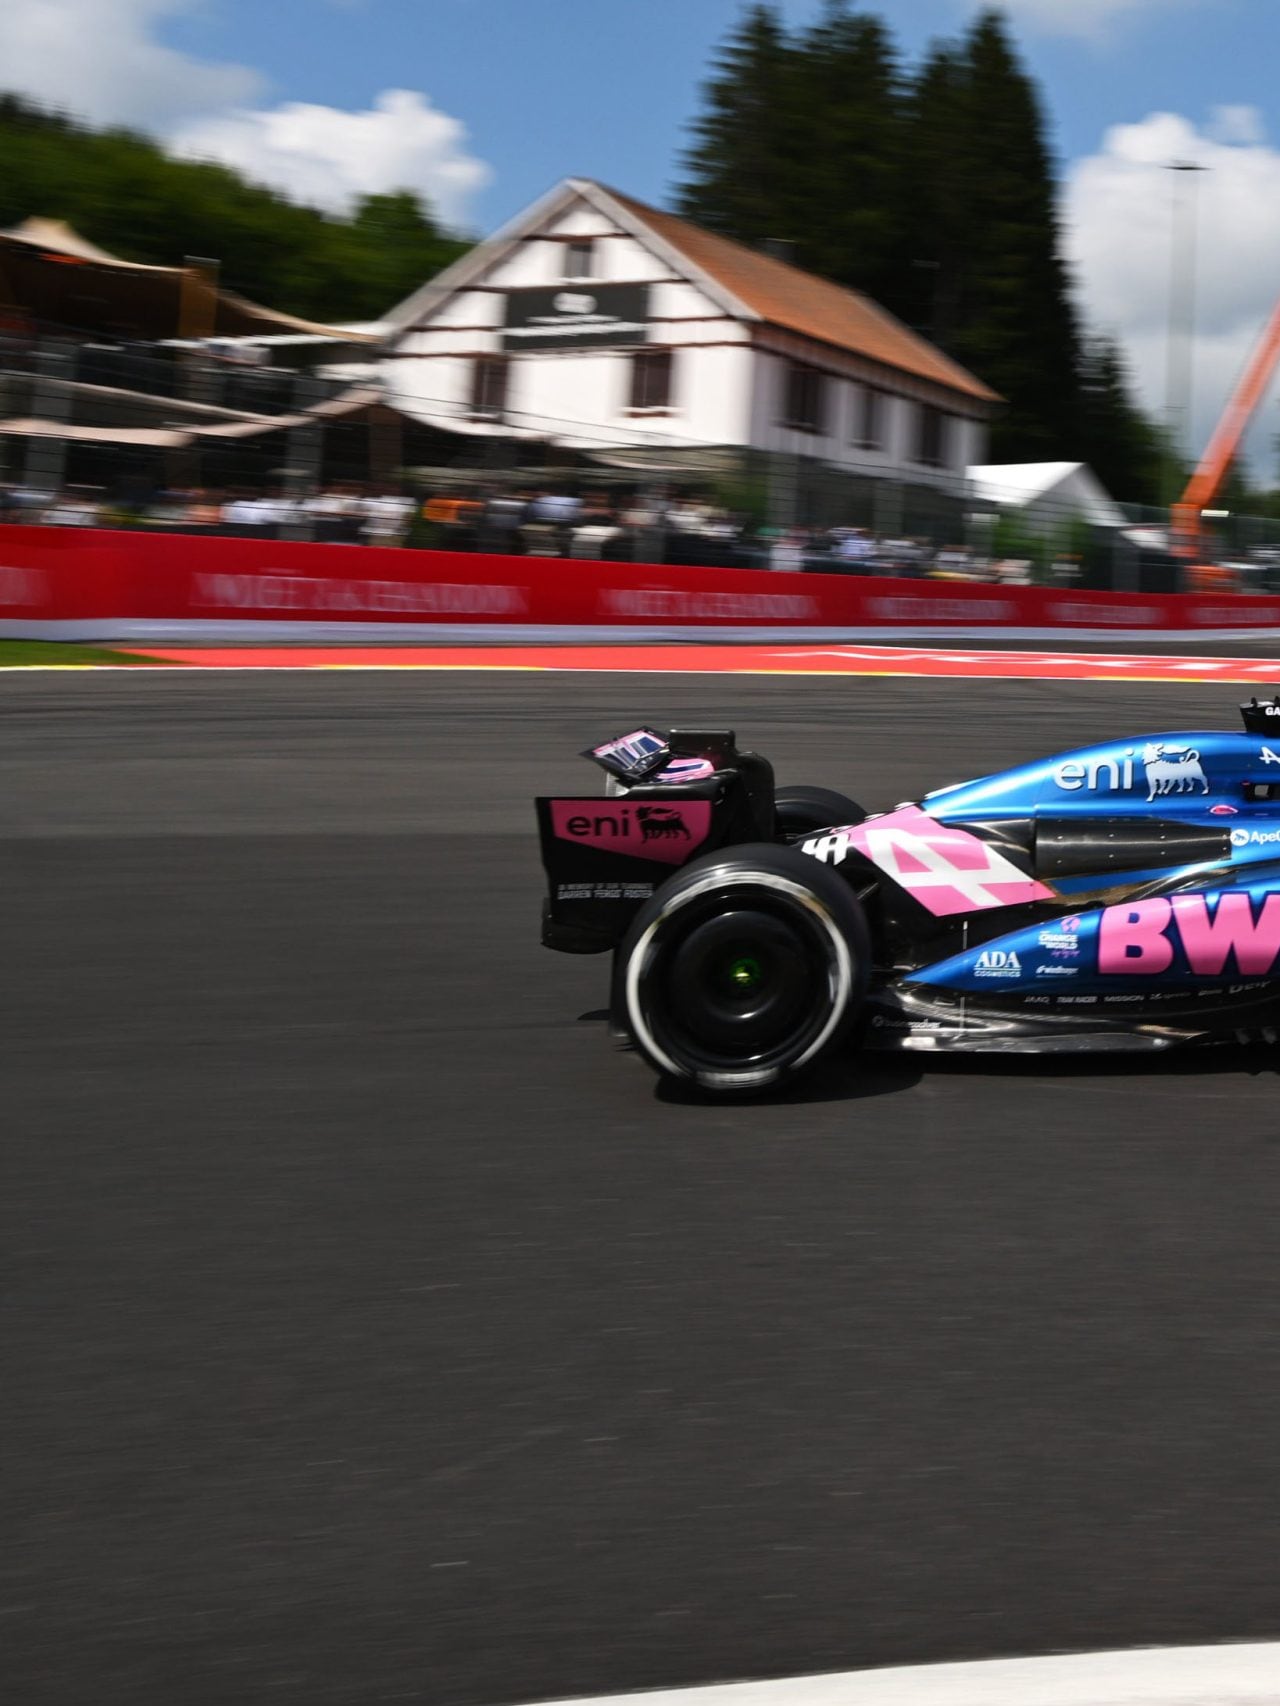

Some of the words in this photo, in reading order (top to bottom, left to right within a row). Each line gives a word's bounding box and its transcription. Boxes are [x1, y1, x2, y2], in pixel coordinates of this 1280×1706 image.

[1053, 748, 1134, 790] eni
[566, 808, 630, 837] eni
[974, 951, 1022, 968] ADA
